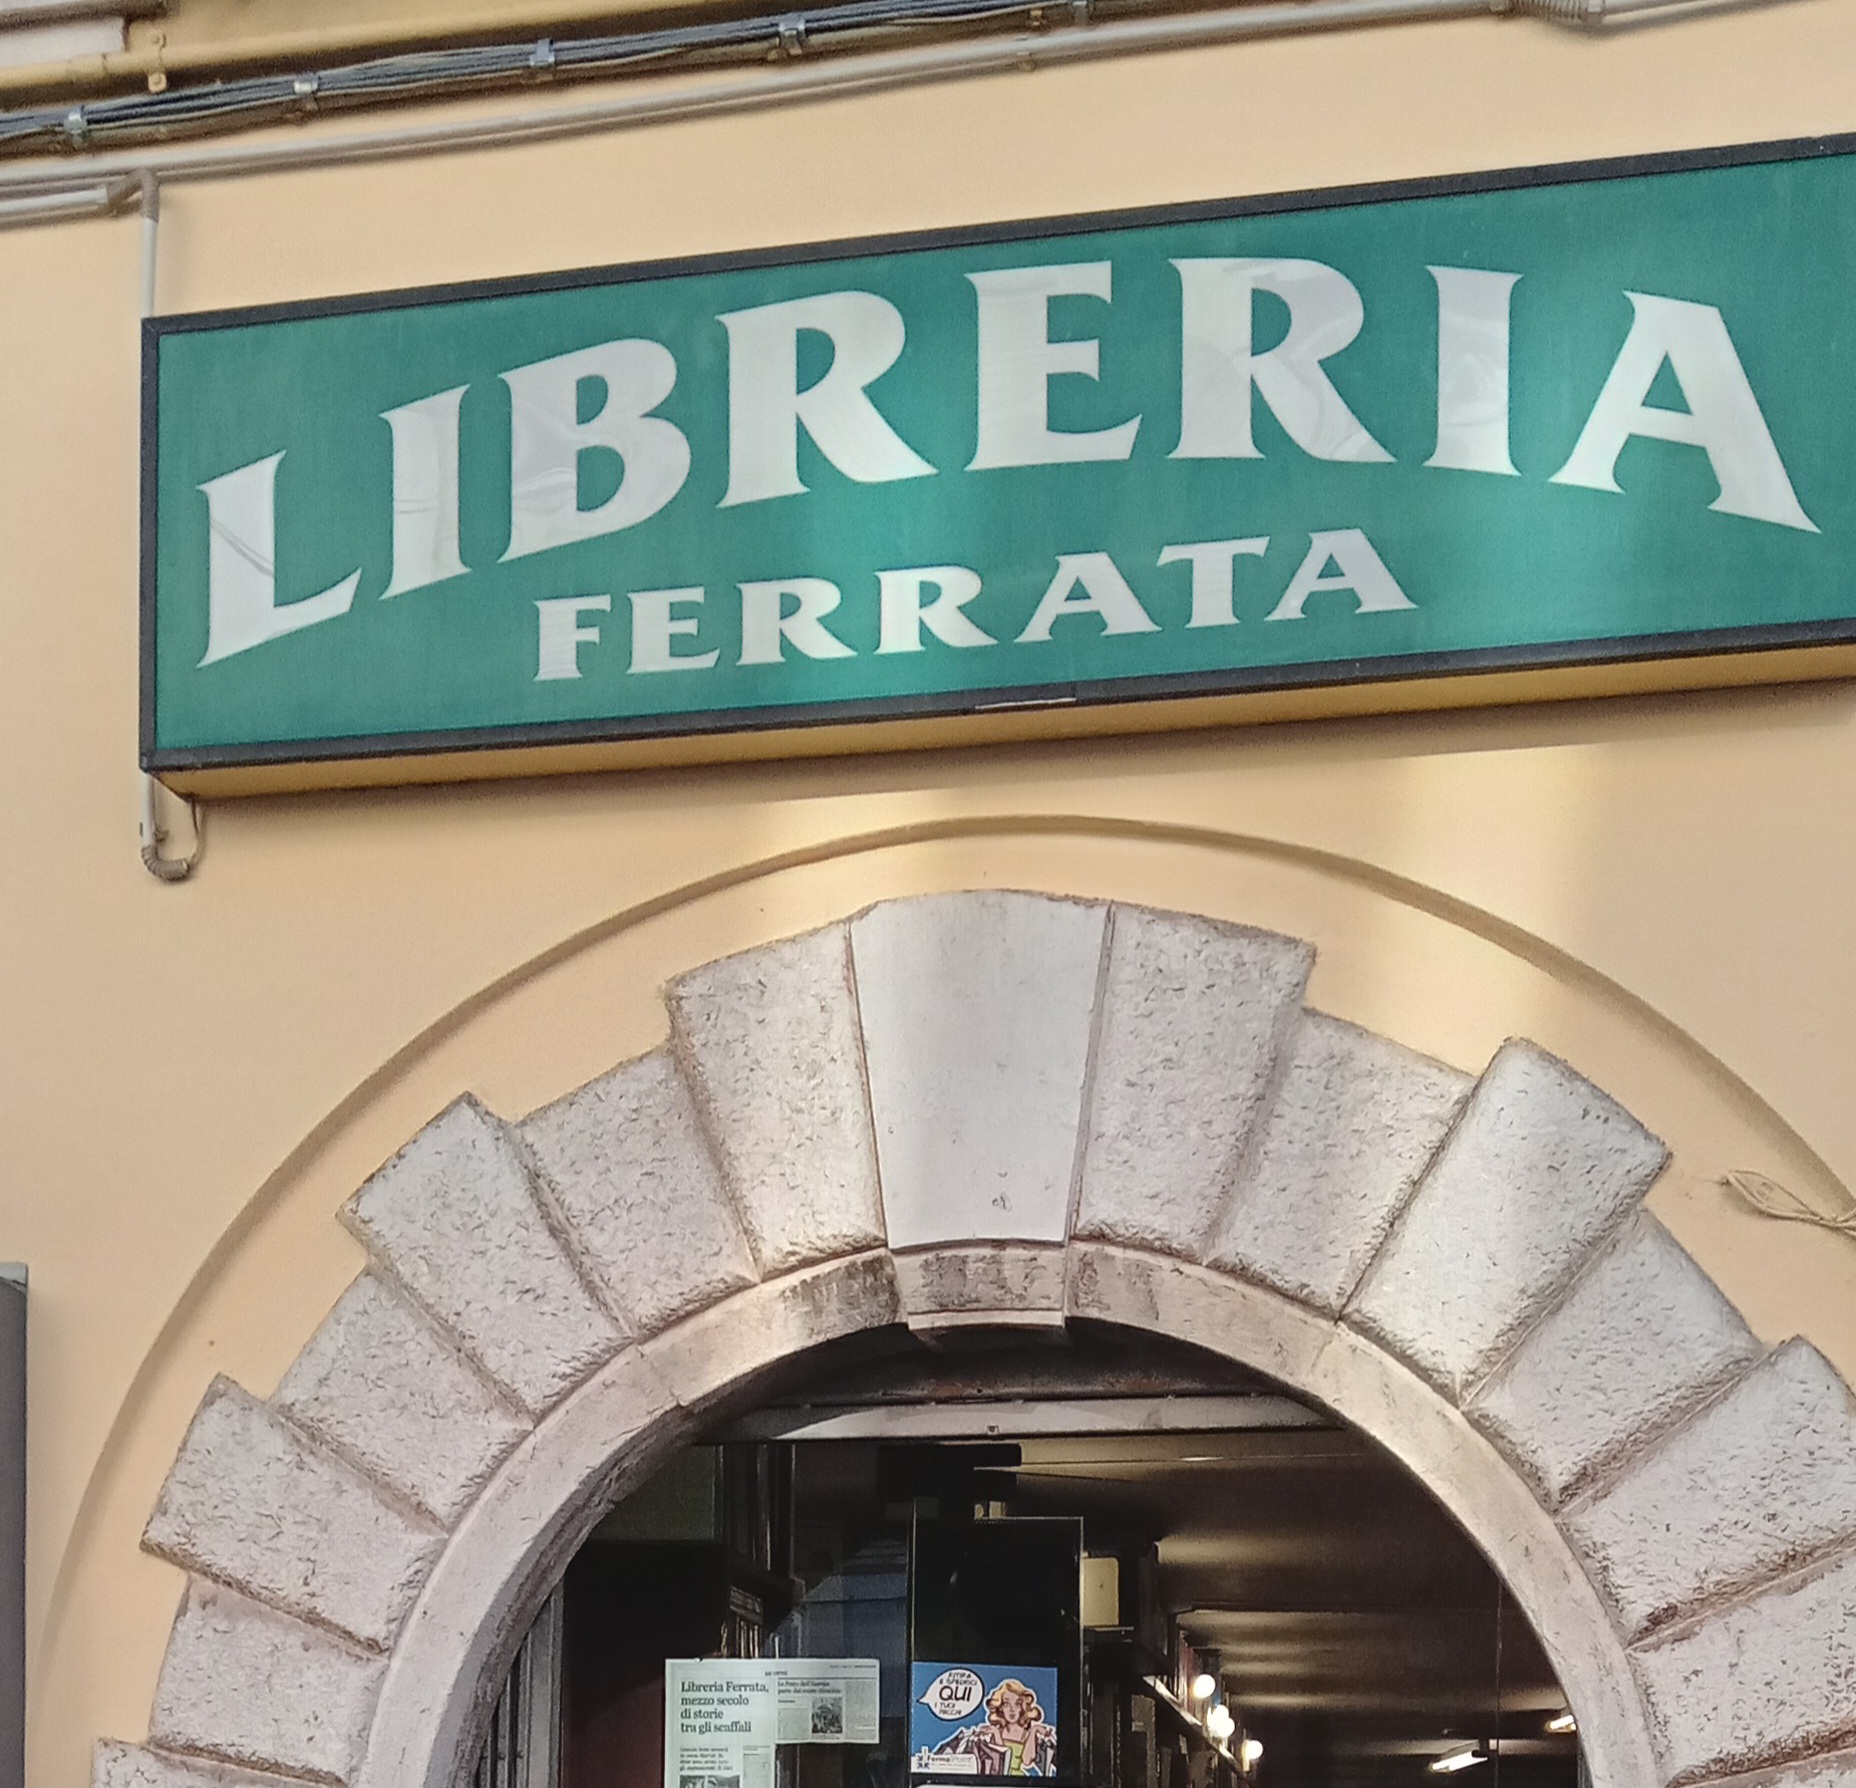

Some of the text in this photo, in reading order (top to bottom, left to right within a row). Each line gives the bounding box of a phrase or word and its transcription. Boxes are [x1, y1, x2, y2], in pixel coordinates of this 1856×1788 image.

[196, 256, 1821, 669] LIBRERIA
[532, 527, 1418, 682] FERRATA
[680, 1681, 724, 1693] Libreria
[725, 1681, 769, 1694] Ferrata,
[939, 1685, 973, 1702] QUI
[680, 1694, 750, 1706] mezzo secolo
[680, 1708, 724, 1720] di storie
[680, 1721, 752, 1735] tra gli scaffali
